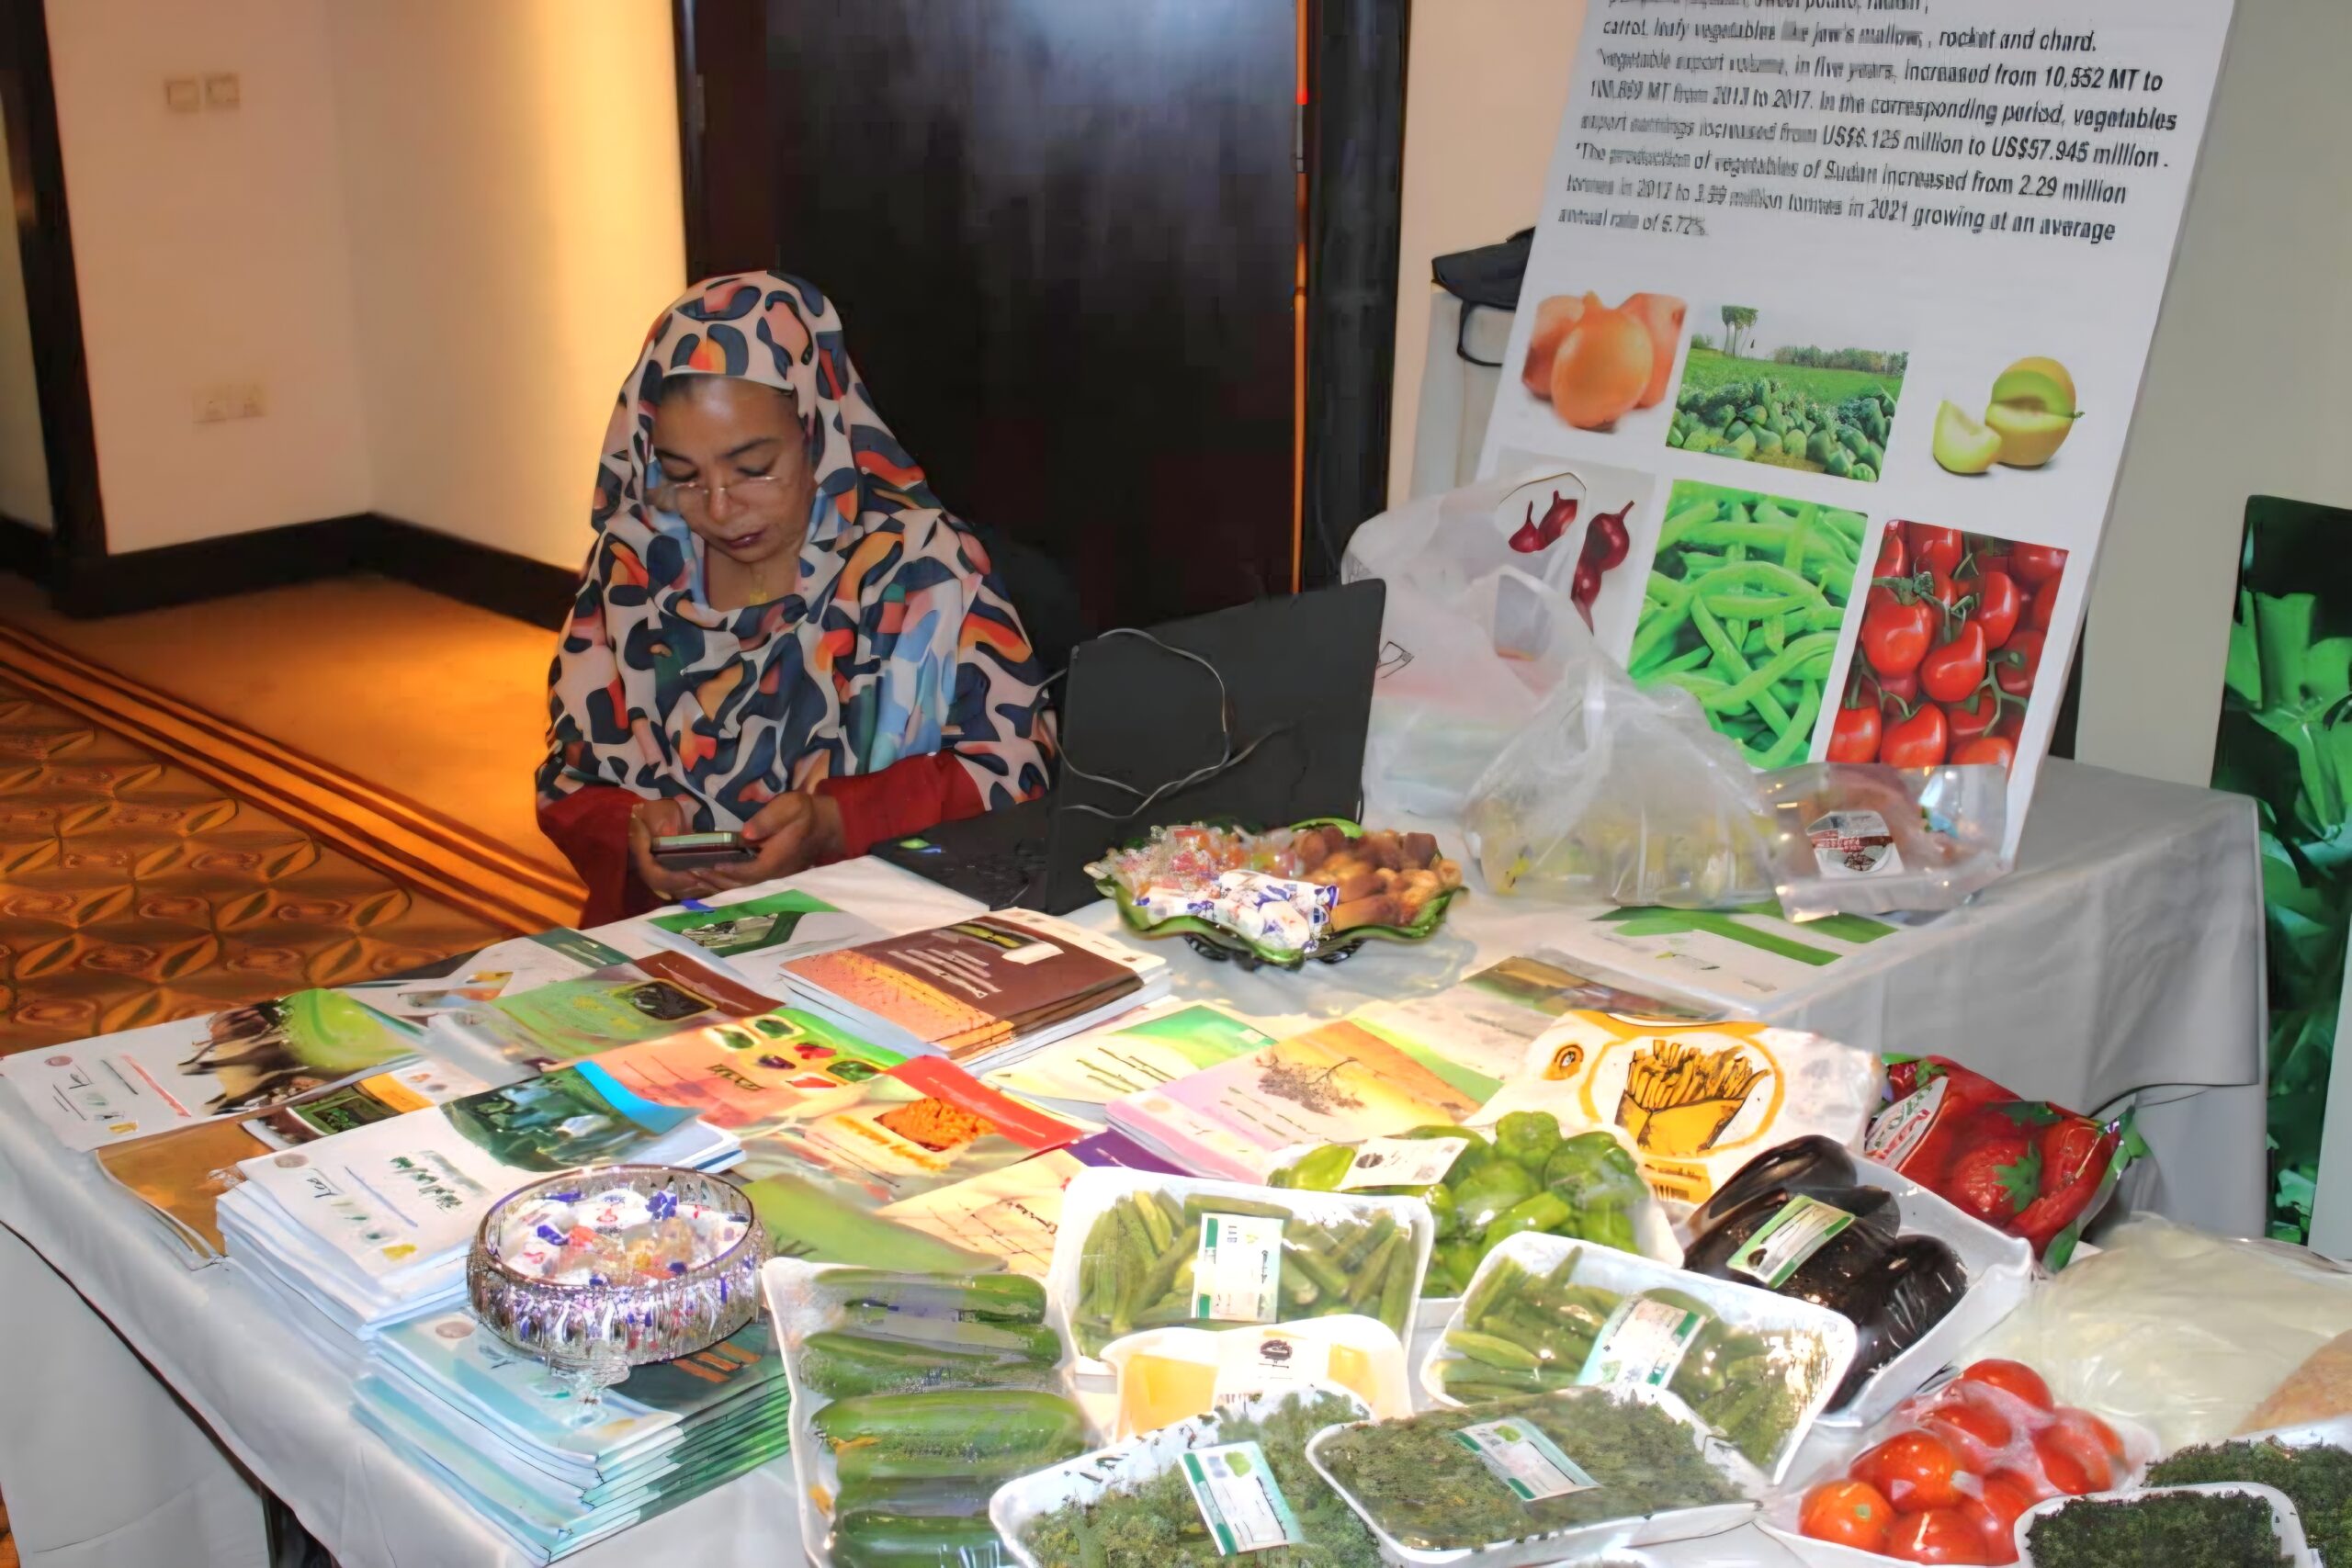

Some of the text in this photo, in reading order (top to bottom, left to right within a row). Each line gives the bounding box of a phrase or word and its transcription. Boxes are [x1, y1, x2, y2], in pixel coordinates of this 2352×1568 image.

[2000, 28, 2035, 49] and
[1795, 55, 1810, 74] in
[1905, 59, 1991, 84] increased
[1995, 63, 2037, 86] from
[2108, 69, 2140, 91] MT
[2143, 71, 2164, 92] to
[1838, 93, 1865, 113] the
[1871, 97, 1997, 127] corresponding
[2074, 107, 2177, 132] vegetables
[1904, 131, 1963, 154] million
[1968, 134, 1985, 156] to
[2093, 141, 2159, 168] million
[1694, 150, 1713, 169] of
[1804, 160, 1822, 178] of
[1883, 164, 1968, 191] increased
[1972, 170, 2013, 194] from
[2063, 179, 2127, 204] million
[1643, 213, 1659, 231] of
[1849, 196, 1864, 218] in
[1912, 206, 1984, 233] growing
[1990, 211, 2007, 231] at
[2012, 216, 2035, 232] an
[2040, 219, 2116, 243] average
